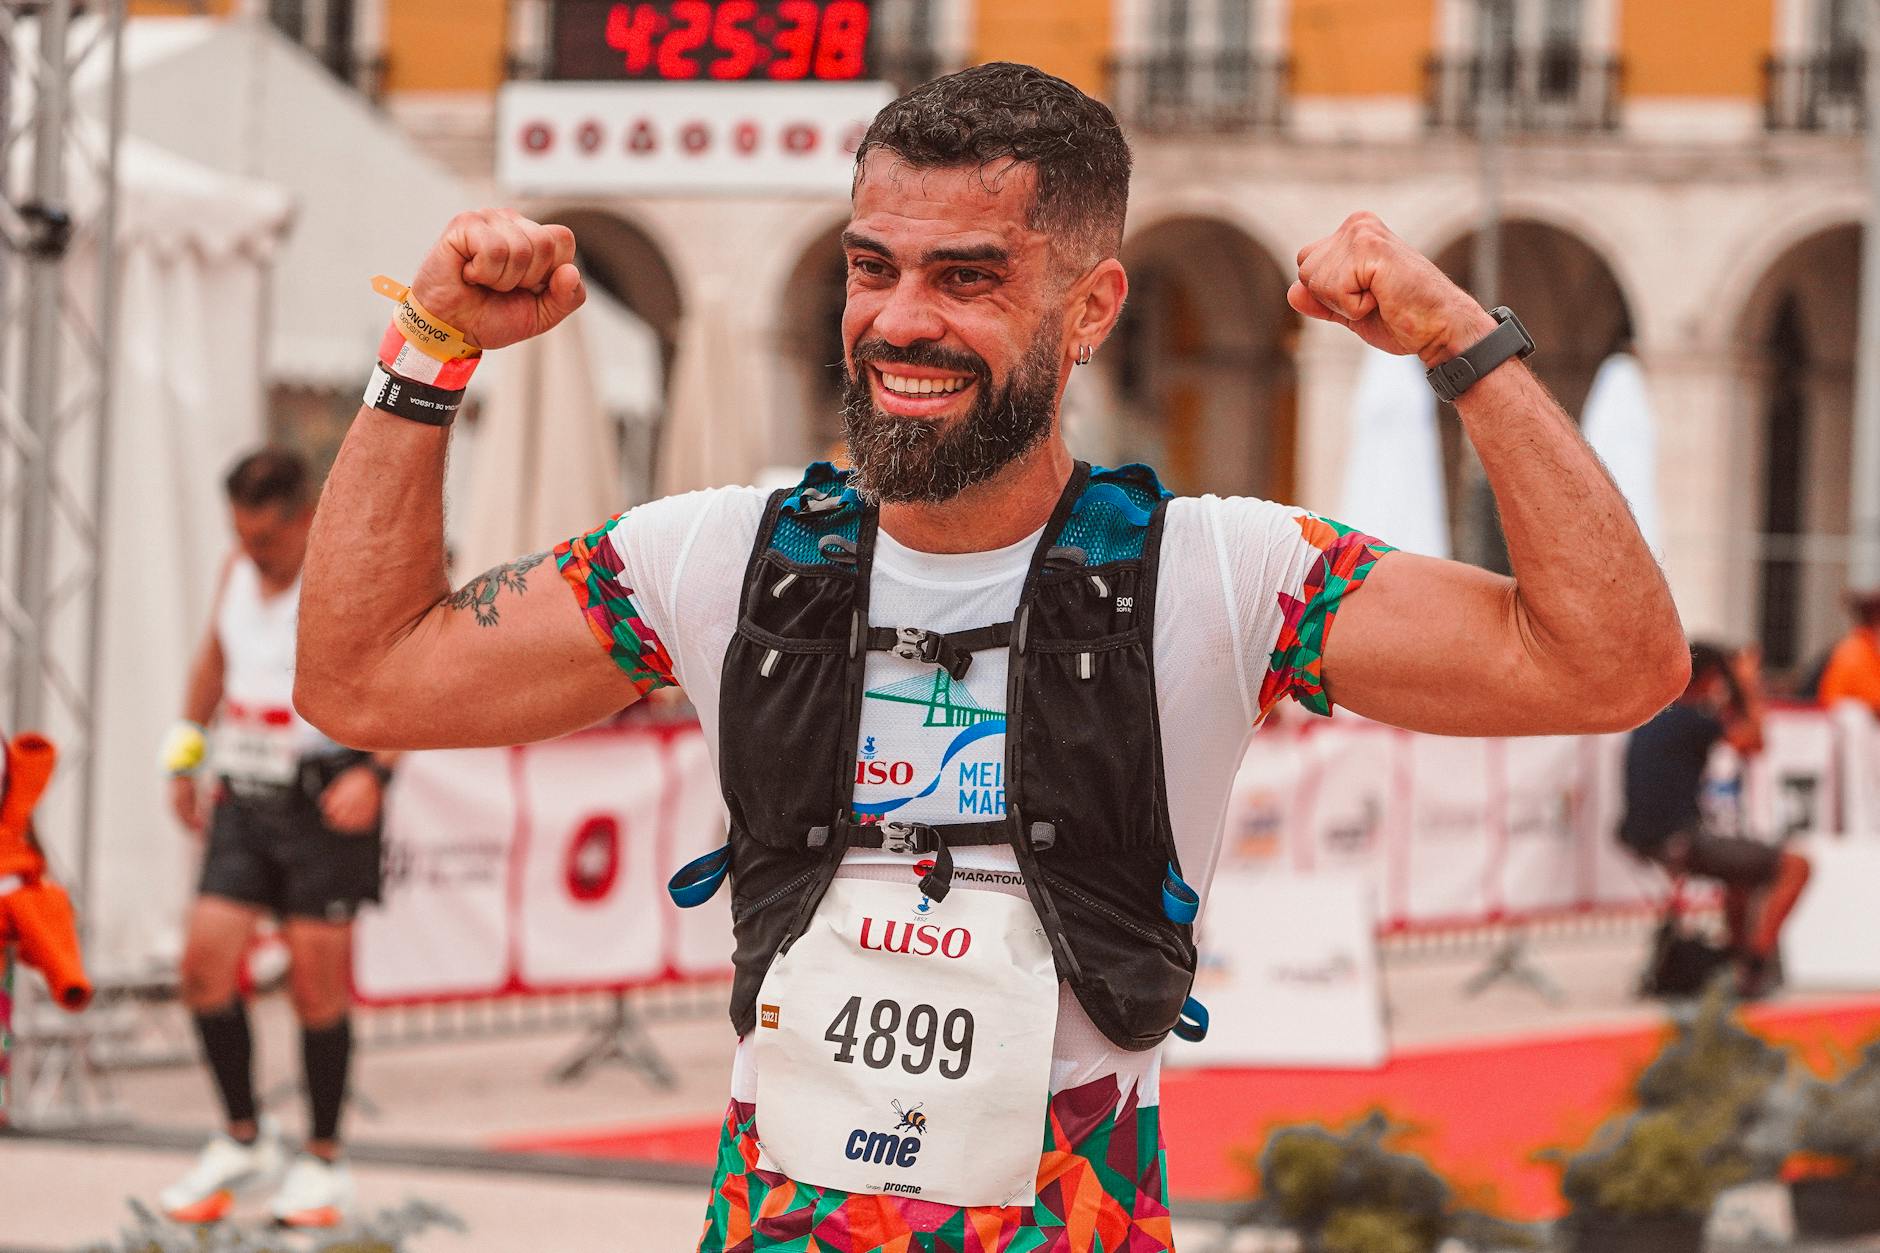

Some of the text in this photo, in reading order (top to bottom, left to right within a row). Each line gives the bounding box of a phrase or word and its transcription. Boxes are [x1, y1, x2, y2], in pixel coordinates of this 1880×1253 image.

[386, 382, 402, 407] FREE
[410, 397, 434, 408] LISBOA
[1116, 597, 1133, 607] 500
[959, 762, 1005, 787] MEI
[953, 871, 1025, 886] MARATON
[859, 917, 972, 959] LUSO
[762, 1010, 778, 1023] 2021
[824, 996, 975, 1080] 4899
[845, 1129, 921, 1168] cme
[883, 1182, 922, 1194] procme
